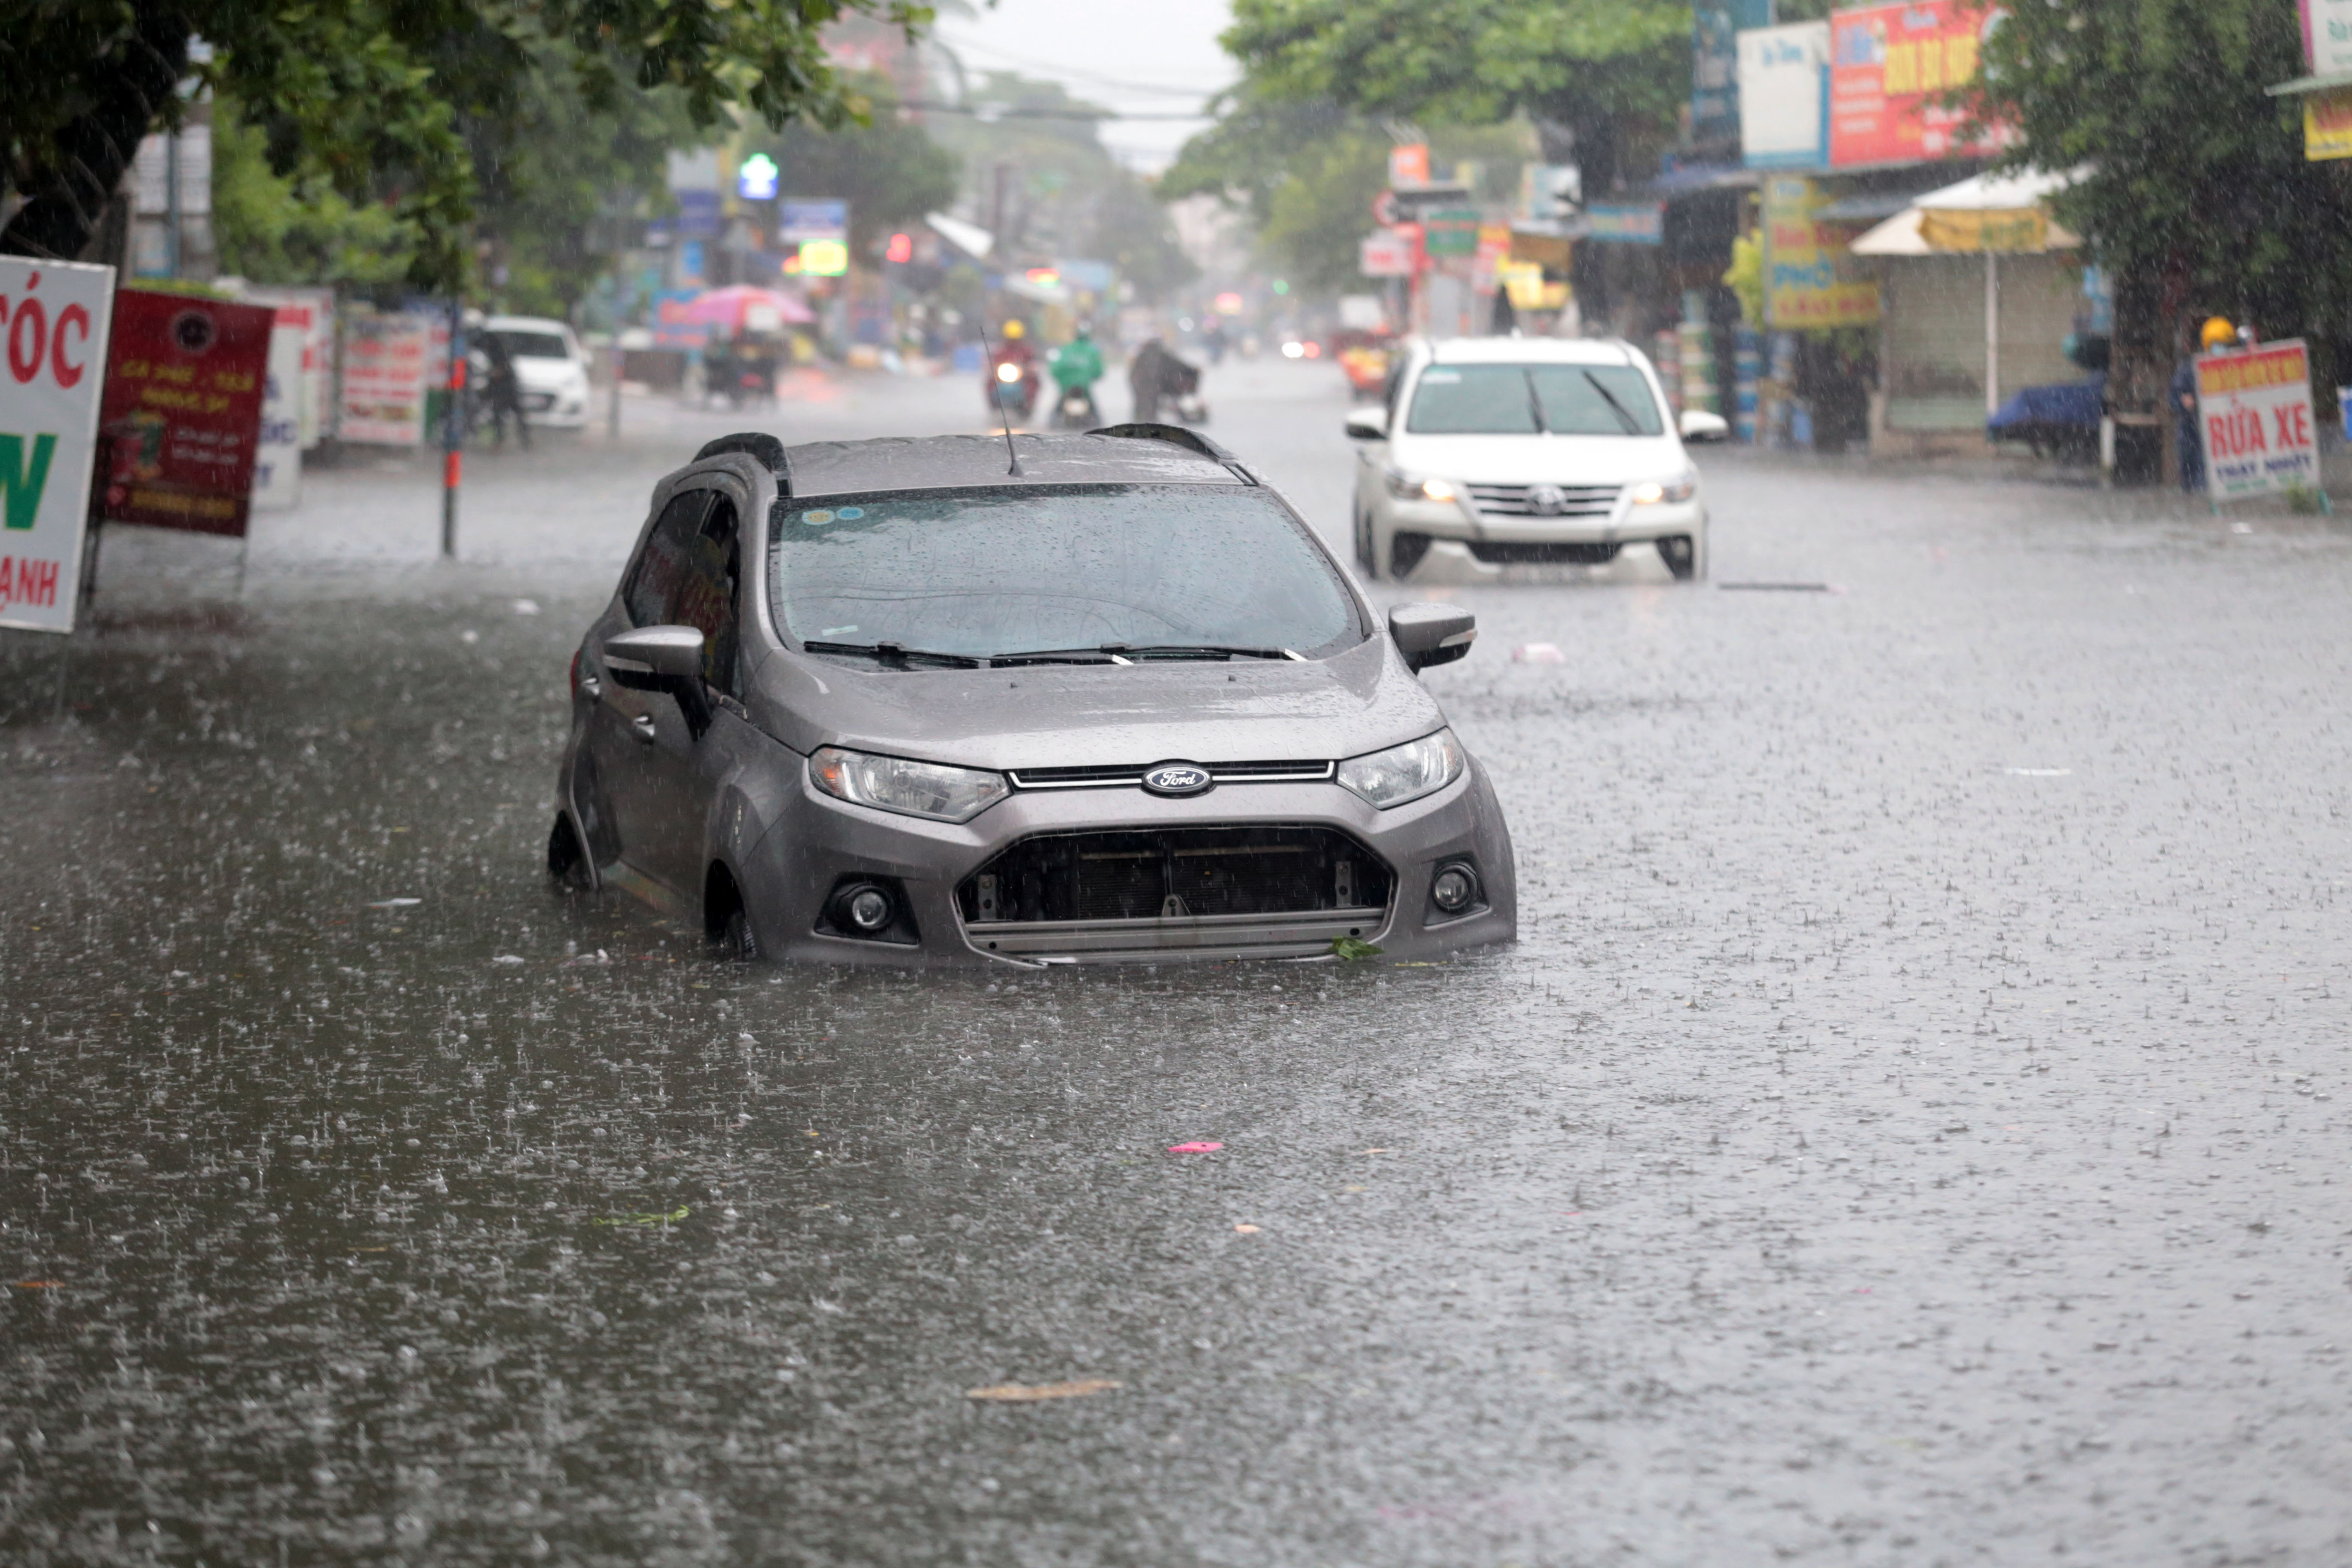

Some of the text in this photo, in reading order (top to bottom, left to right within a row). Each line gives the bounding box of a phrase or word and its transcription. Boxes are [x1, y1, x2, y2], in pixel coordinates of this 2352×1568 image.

[0, 271, 90, 389] ÓC
[2273, 402, 2312, 449] XE
[1160, 771, 1196, 786] Ford
